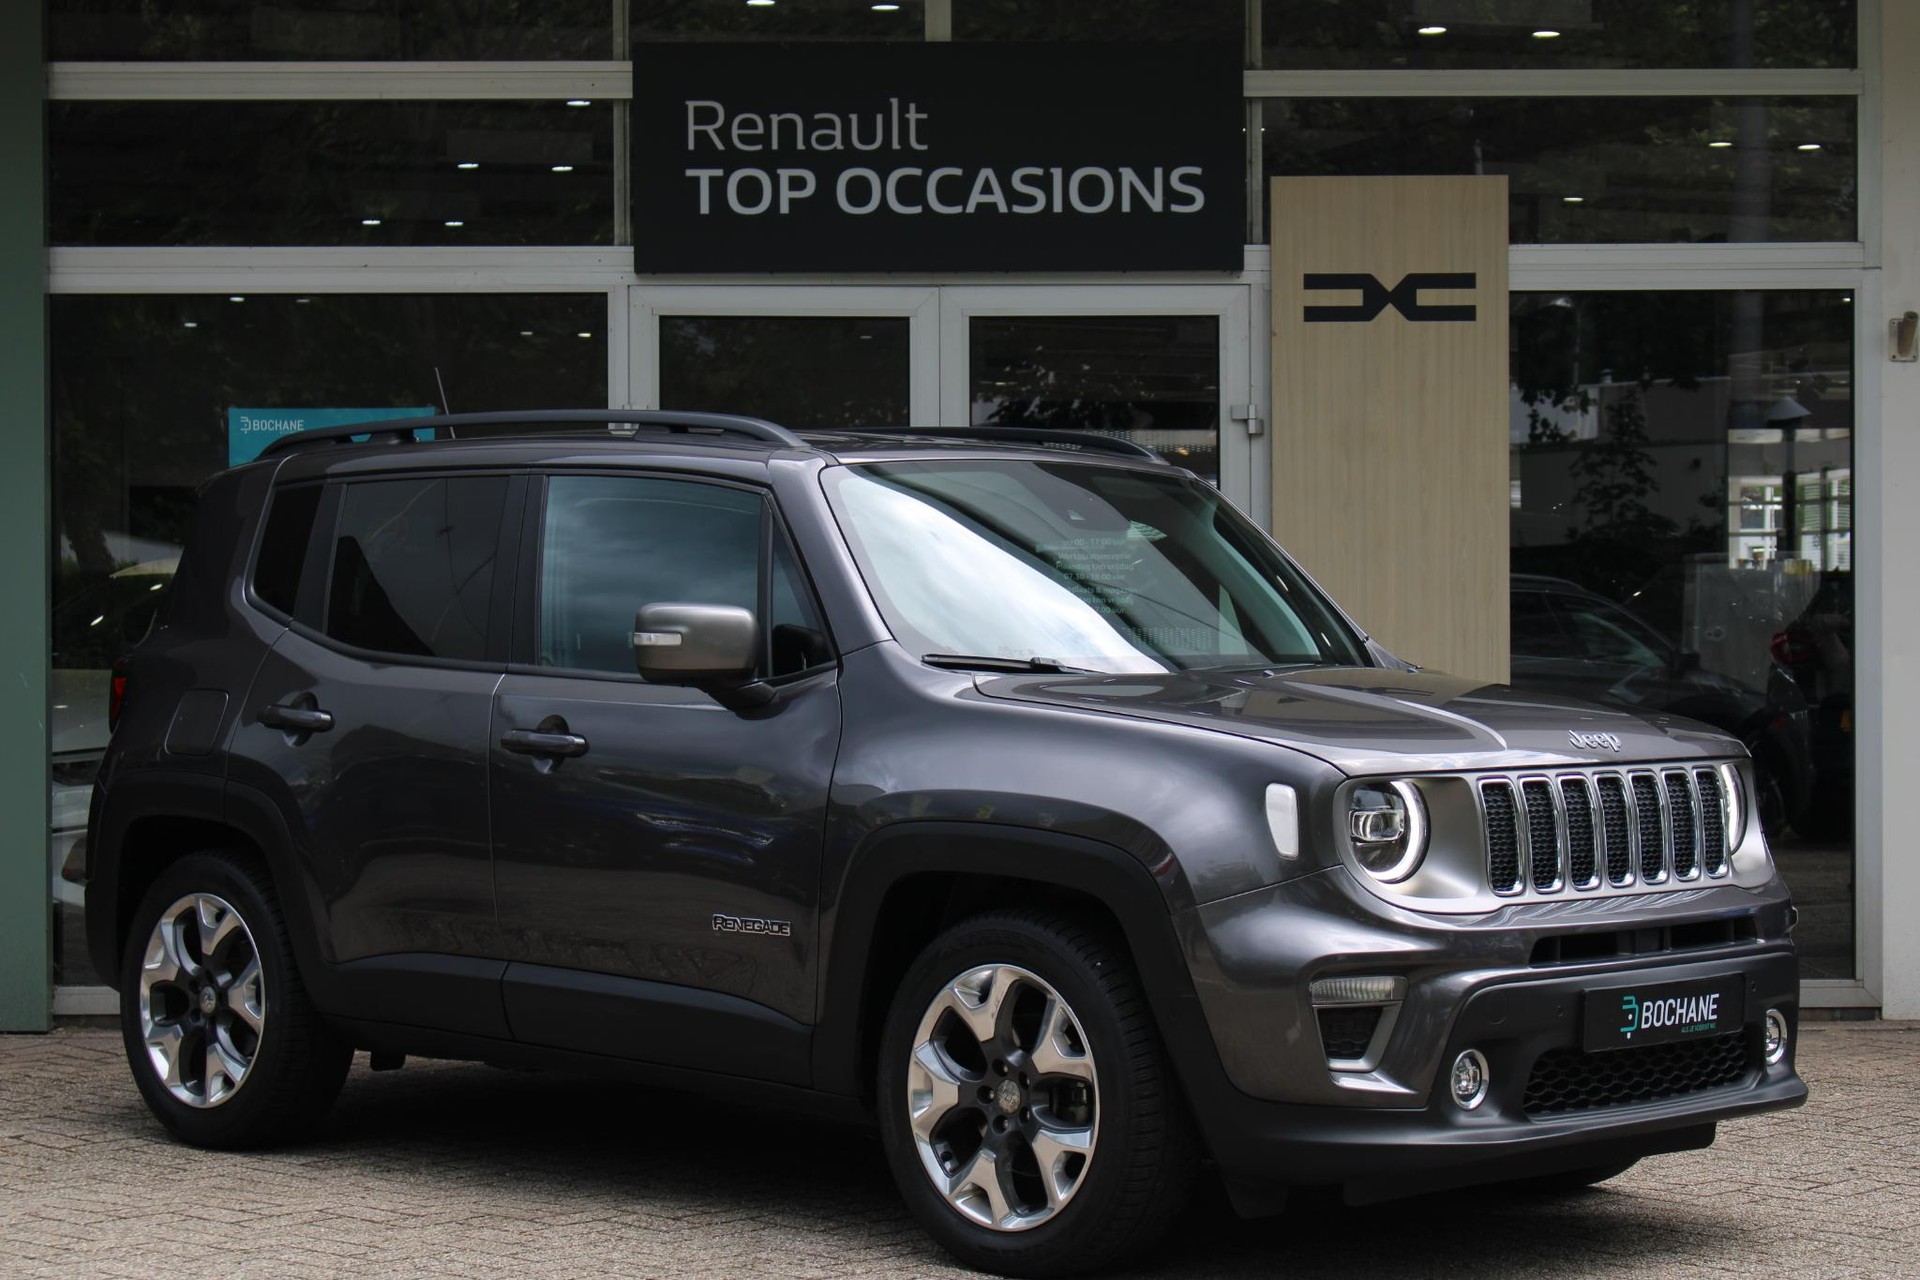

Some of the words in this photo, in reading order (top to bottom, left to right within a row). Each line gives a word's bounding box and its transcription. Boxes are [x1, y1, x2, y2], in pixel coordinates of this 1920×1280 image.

[685, 98, 928, 151] Renault
[685, 167, 816, 215] TOP
[836, 166, 1205, 214] OCCASIONS
[252, 419, 305, 432] BOCHANE
[1567, 729, 1621, 753] Jeep
[711, 913, 792, 937] RENEGADE
[1641, 993, 1720, 1029] BOCHANE
